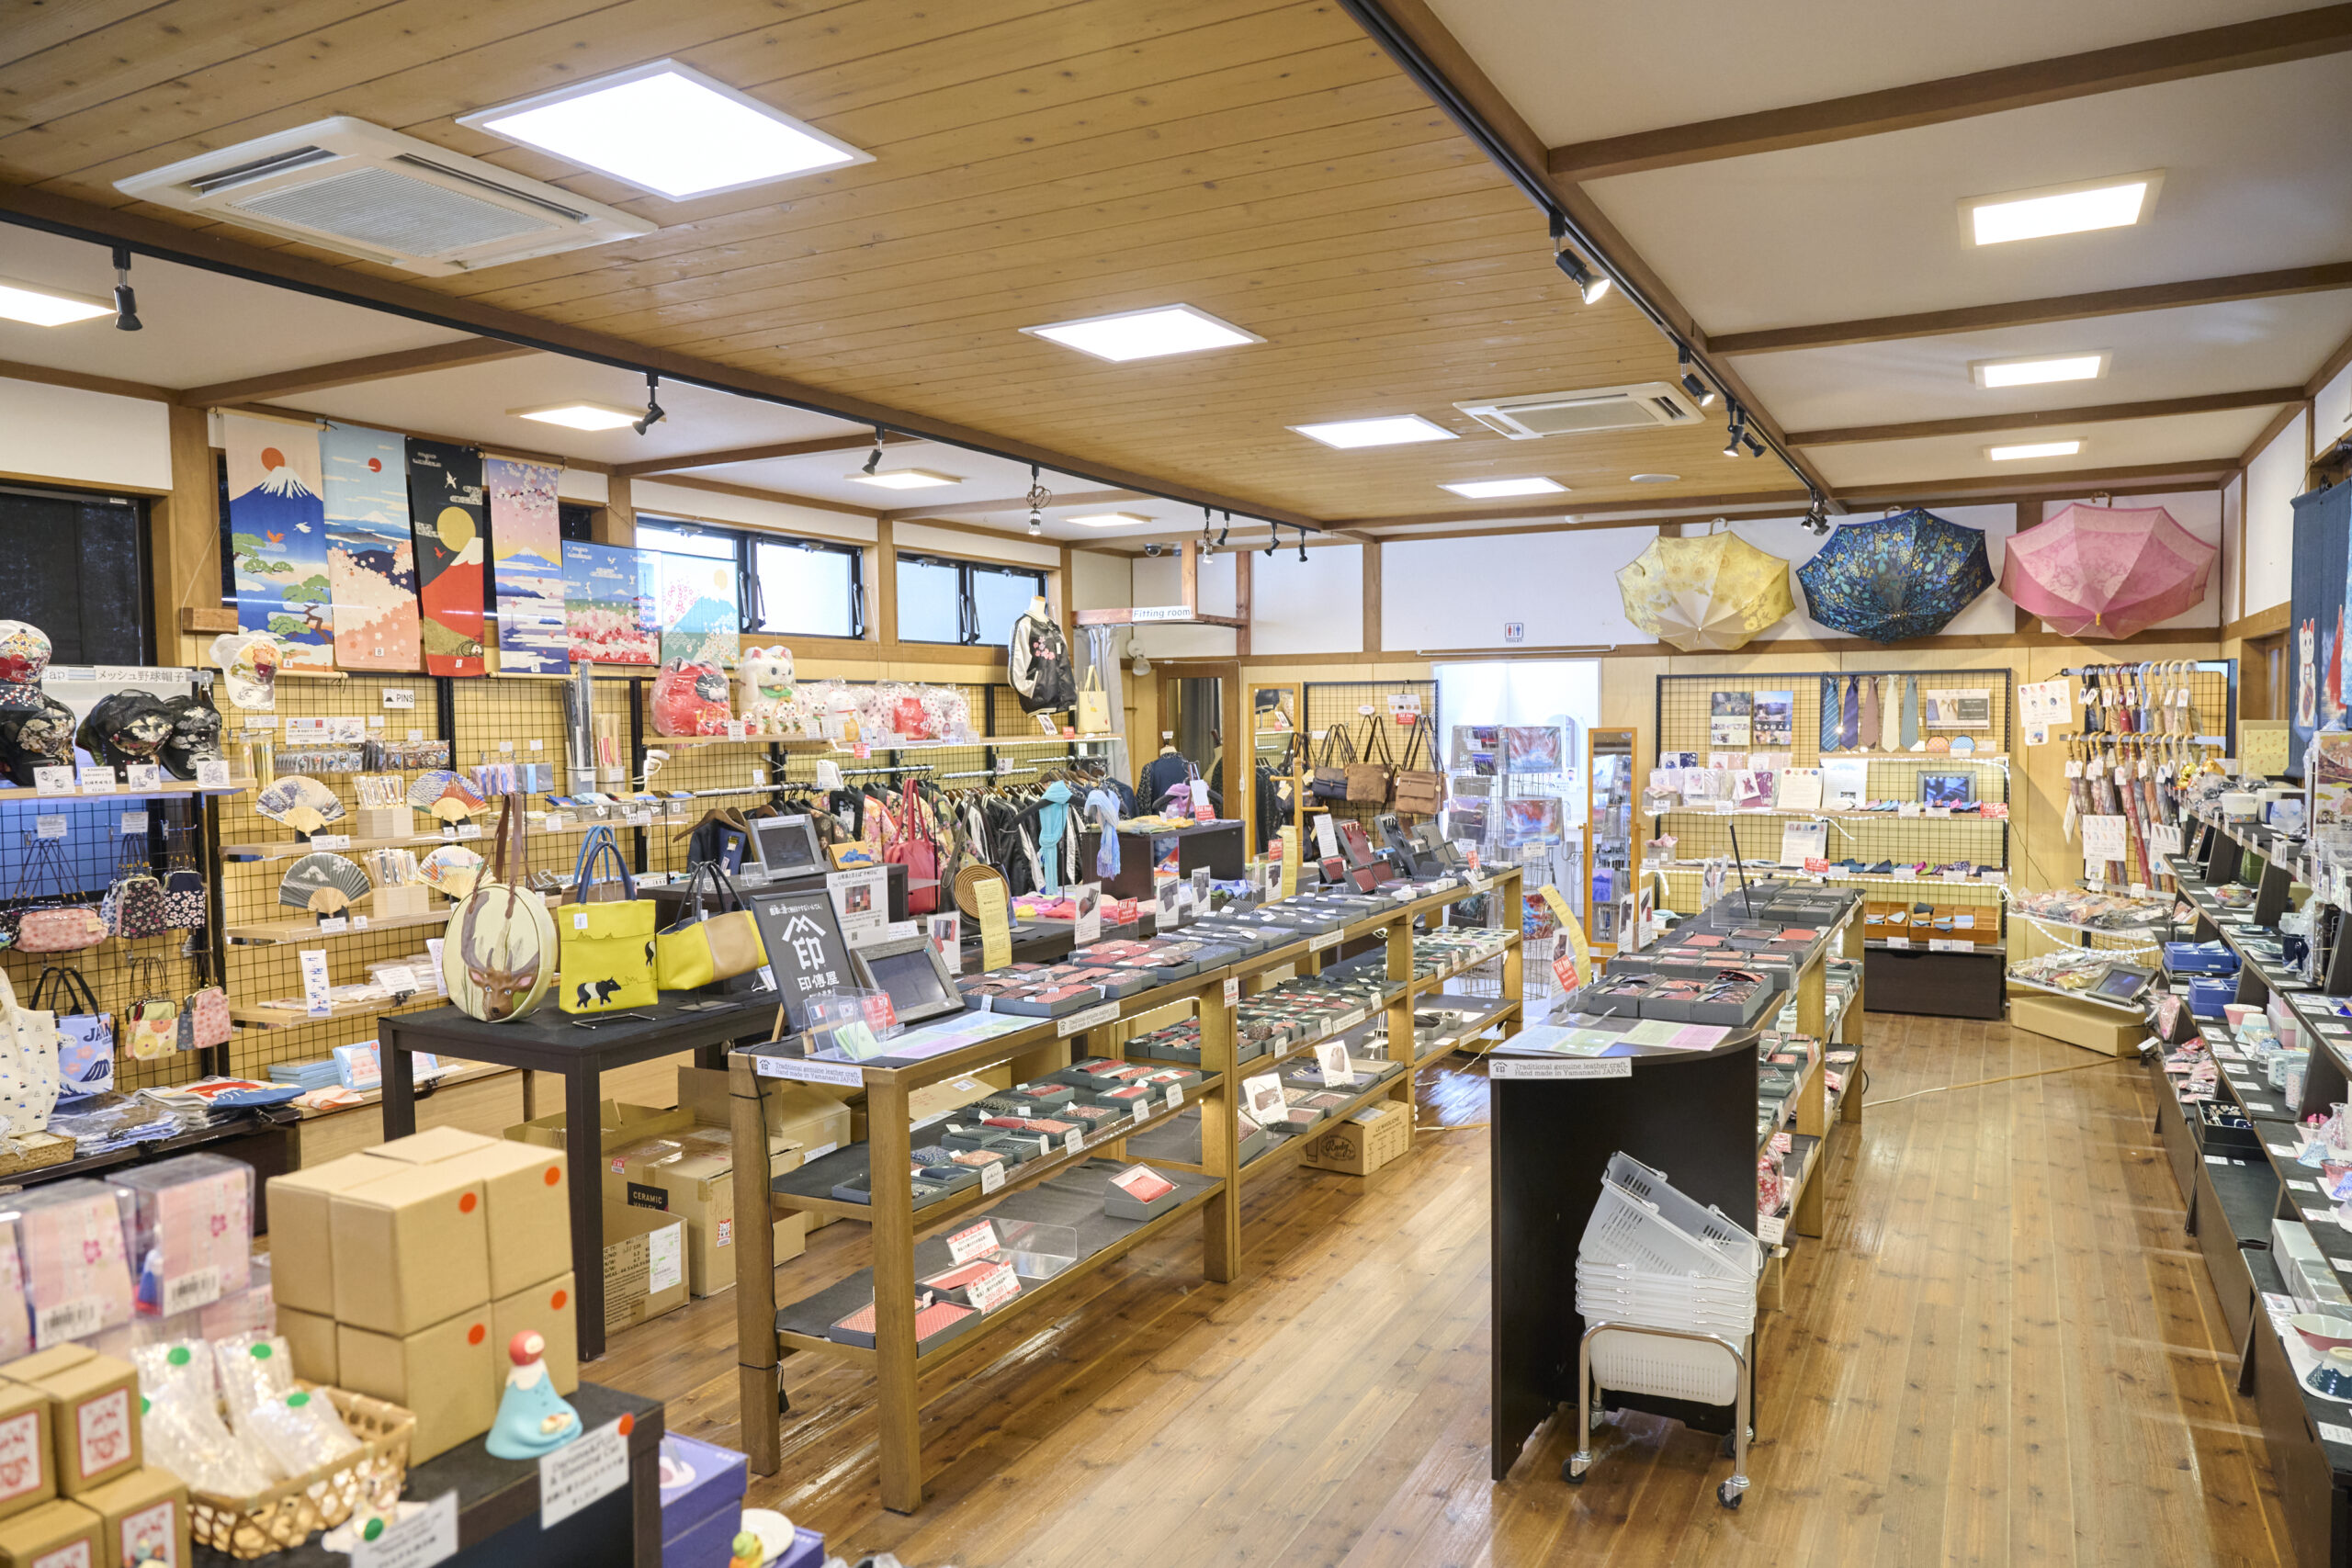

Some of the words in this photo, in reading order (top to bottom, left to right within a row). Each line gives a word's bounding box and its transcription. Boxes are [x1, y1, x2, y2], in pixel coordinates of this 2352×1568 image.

[1133, 609, 1165, 619] Fitting
[1167, 608, 1191, 616] room
[97, 670, 185, 682] メッシュ野球帽子
[396, 694, 413, 703] PINS
[792, 935, 826, 971] 印
[797, 970, 840, 992] 印傳屋
[775, 1062, 802, 1072] Traditional
[803, 1066, 824, 1074] genuine
[825, 1066, 844, 1076] leather
[1514, 1063, 1553, 1071] Traditional
[810, 1073, 840, 1081] Yamanashi
[632, 1190, 662, 1204] CERAMIC
